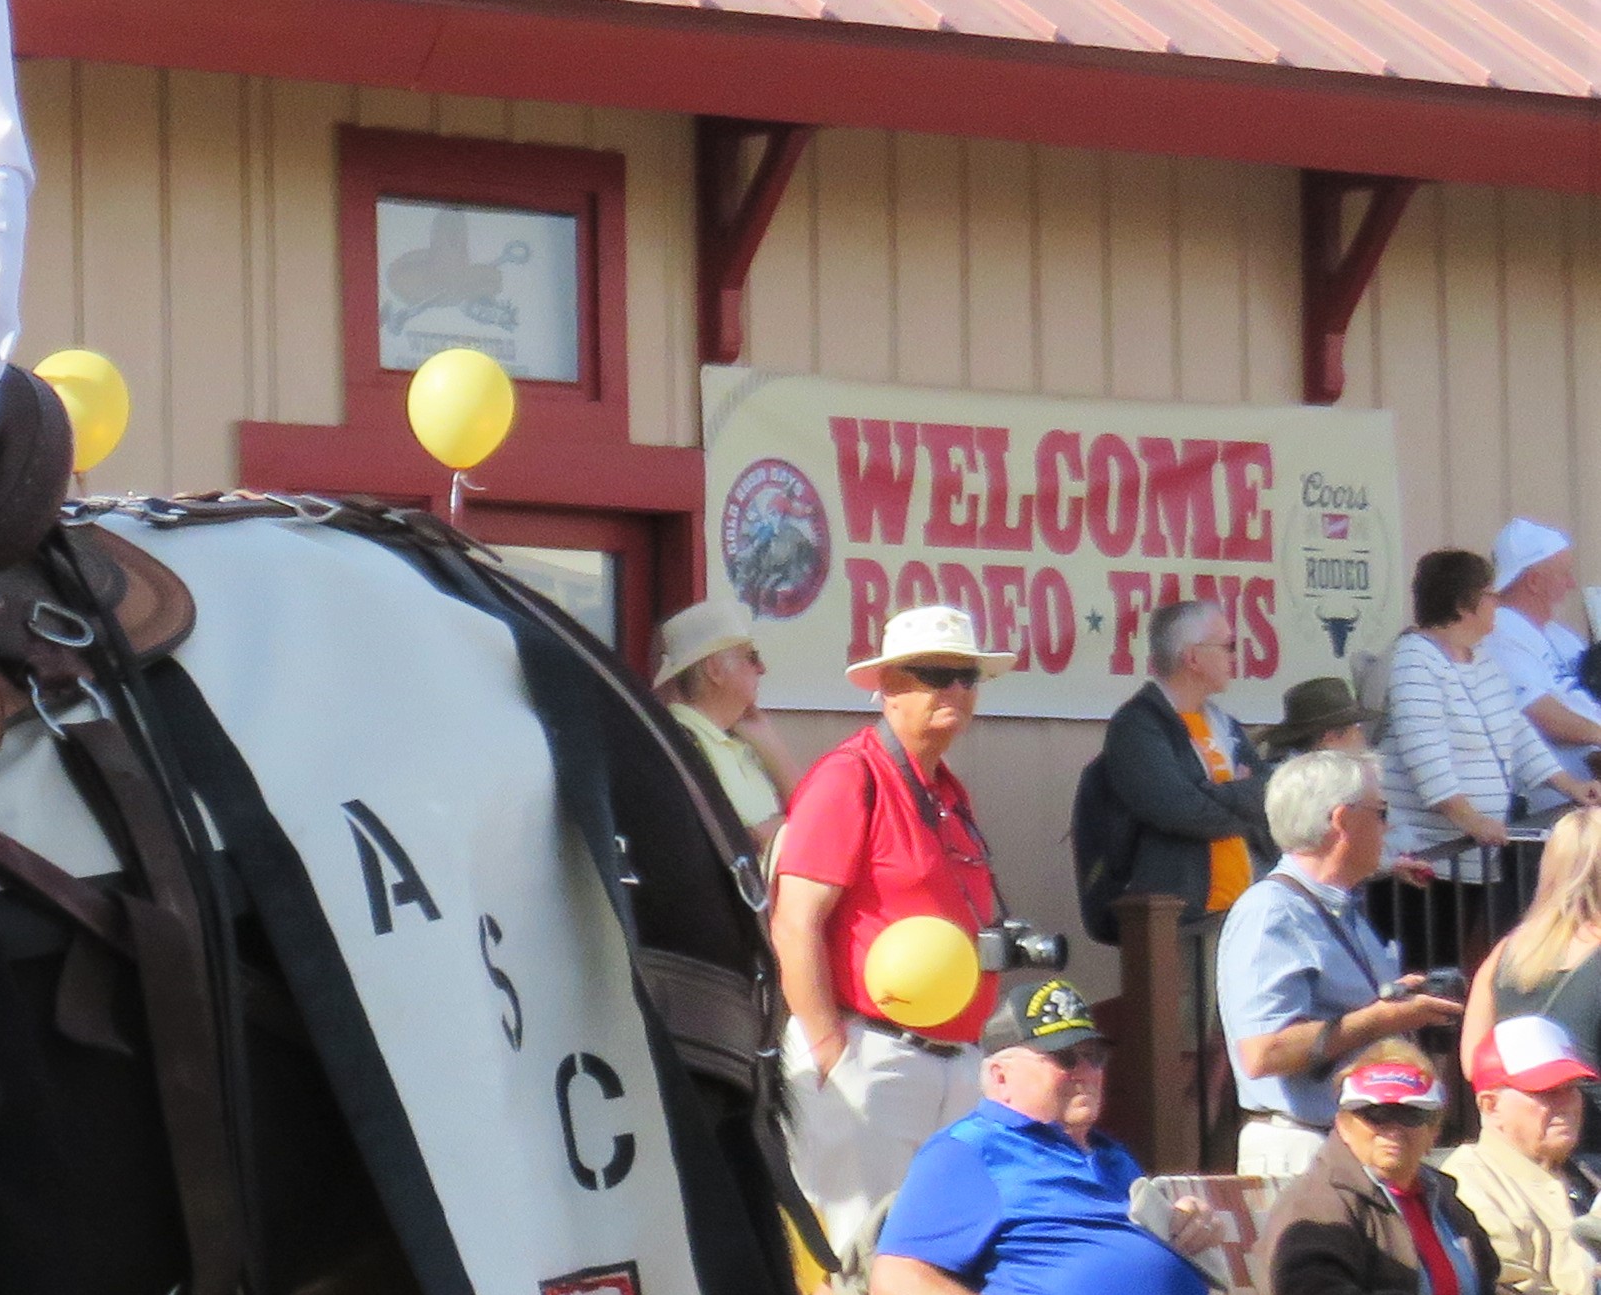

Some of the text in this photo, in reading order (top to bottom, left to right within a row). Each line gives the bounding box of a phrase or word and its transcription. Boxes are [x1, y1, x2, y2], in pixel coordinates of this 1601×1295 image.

[828, 415, 1274, 563] WELCOME
[1300, 471, 1370, 510] Coors
[1305, 556, 1370, 591] RODEO
